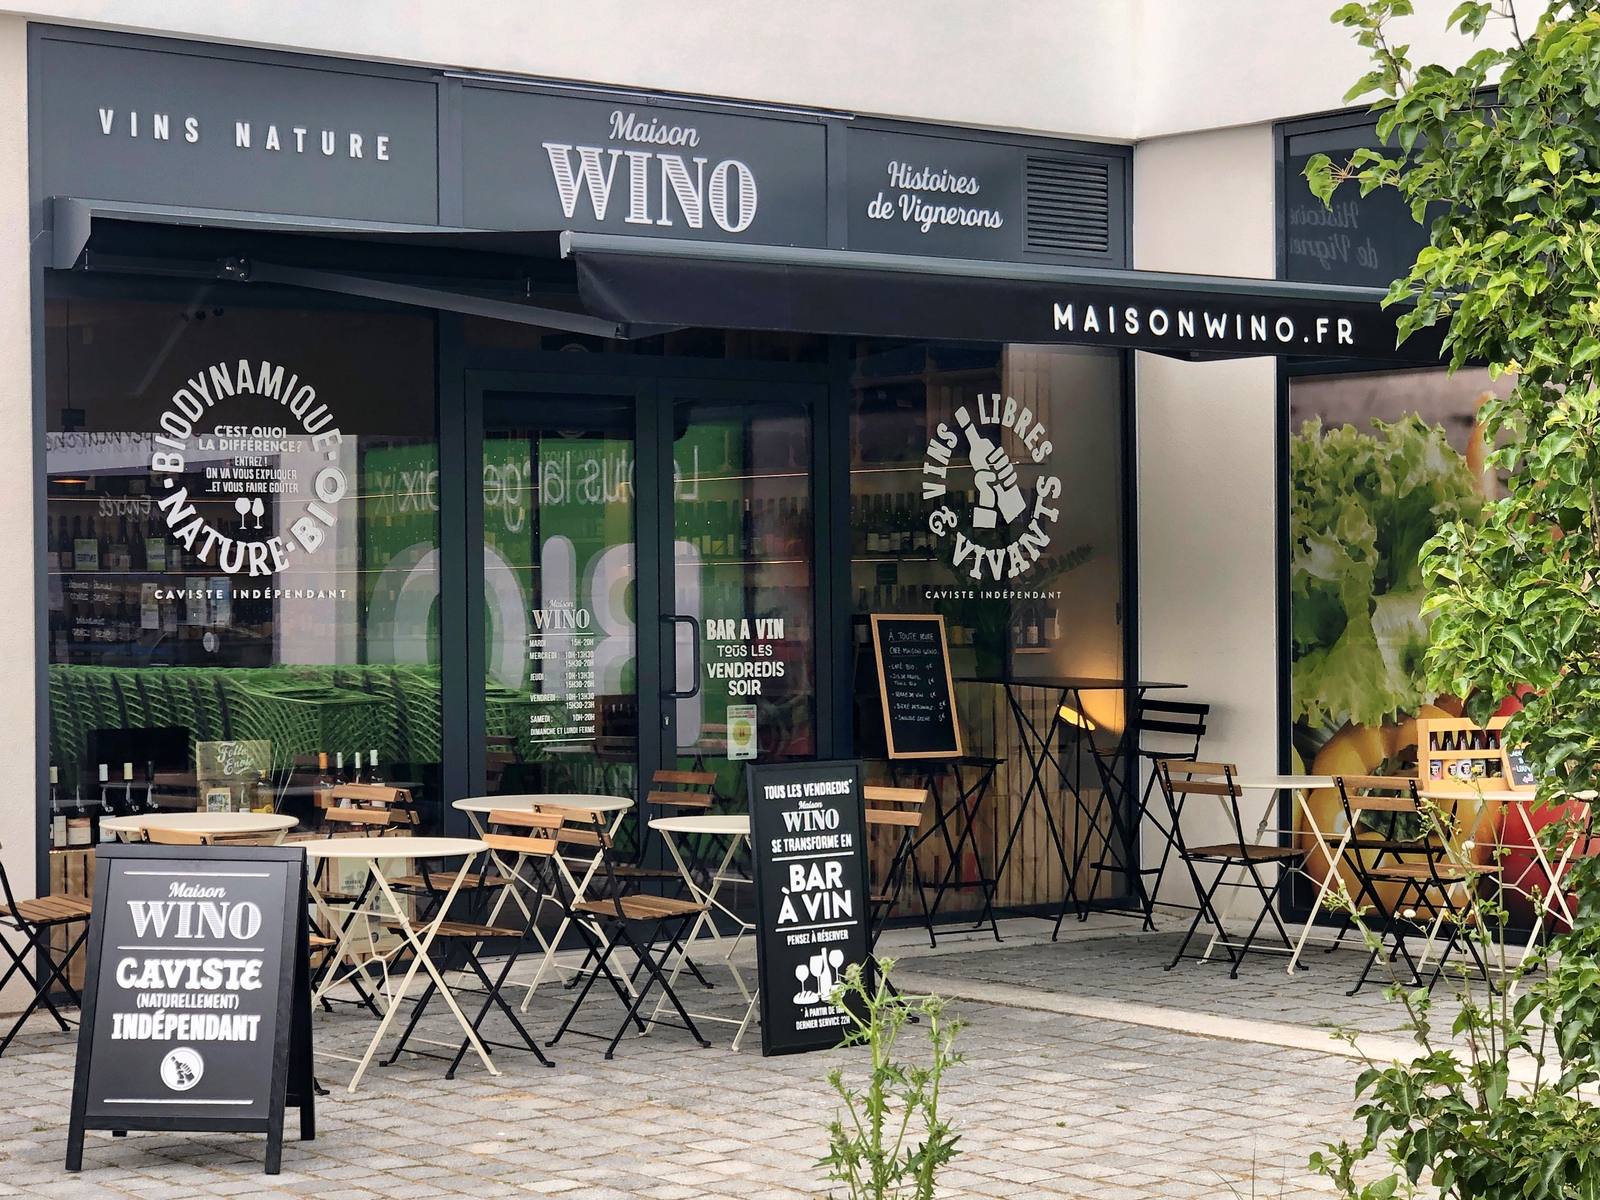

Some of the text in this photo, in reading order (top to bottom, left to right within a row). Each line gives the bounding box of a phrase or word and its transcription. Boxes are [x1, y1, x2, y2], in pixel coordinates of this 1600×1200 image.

[99, 108, 391, 162] VINS NATURE
[608, 110, 700, 148] Maison
[542, 141, 759, 234] WINO
[886, 160, 980, 196] Histoires
[867, 192, 1004, 233] de Vignerons
[1052, 302, 1356, 346] MAISONWINO.FR
[152, 359, 343, 474] BIODYNAMIQUE
[214, 425, 287, 439] C'EST QUOI
[977, 393, 1053, 464] LIBRES
[198, 437, 303, 453] LA DIFFÉRENCE?
[234, 456, 263, 467] ENTREZ
[922, 422, 958, 500] VINS
[206, 467, 297, 481] ON VA VOUS EXPLIQUER
[222, 482, 243, 493] VOUS
[245, 482, 268, 493] FAIRE
[157, 487, 290, 577] NATURE
[290, 465, 348, 554] BIO
[952, 475, 1062, 581] VIVANTS
[154, 587, 347, 600] CAVISTE INDÉPENDANT
[925, 588, 1062, 600] CAVISTE INDÉPENDANT
[532, 608, 591, 630] WINO
[706, 618, 785, 641] BAR A VIN
[716, 644, 773, 657] TOUS LES
[706, 661, 785, 679] VENDREDIS
[728, 680, 762, 696] SOIR
[530, 727, 557, 737] DIMANCHE
[556, 726, 563, 735] ET
[563, 726, 578, 735] LUNDI
[764, 784, 786, 799] TOUS
[787, 783, 802, 798] LES
[781, 808, 840, 833] WINO
[771, 833, 853, 853] SE TRANSFORME EN
[789, 860, 843, 893] BAR
[168, 882, 227, 899] Maison
[777, 886, 853, 924] À VIN
[126, 900, 263, 940] WINO
[786, 929, 849, 946] PENSEZ À RÉSERVER
[115, 957, 264, 990] CAVISTE
[136, 992, 240, 1010] (NATURELLEMENT)
[809, 1006, 828, 1018] PARTIR
[828, 1005, 835, 1015] DE
[110, 1008, 261, 1042] INDÉPENDANT
[795, 1019, 818, 1031] DERNIER
[818, 1016, 840, 1028] SERVICE
